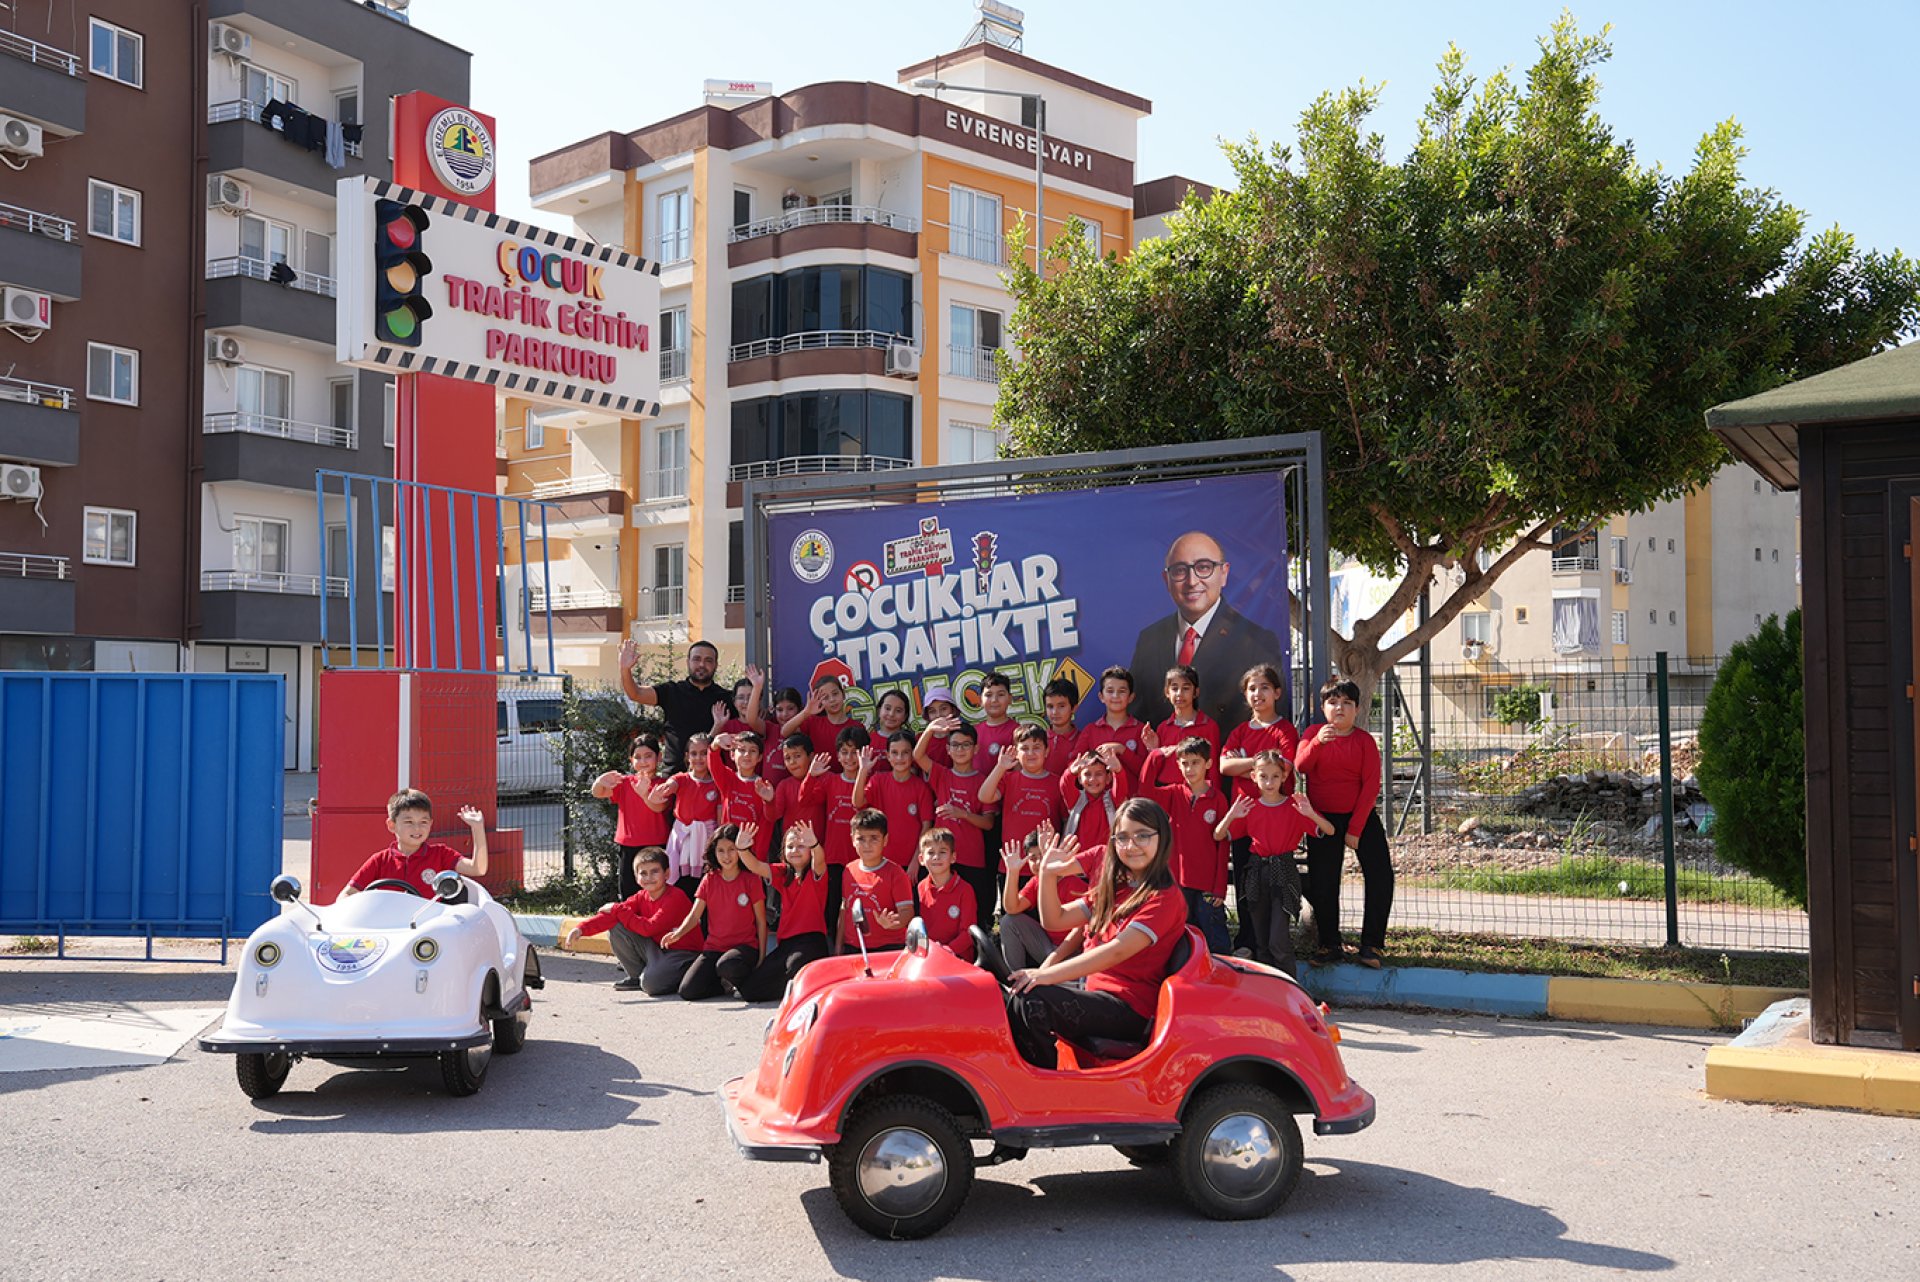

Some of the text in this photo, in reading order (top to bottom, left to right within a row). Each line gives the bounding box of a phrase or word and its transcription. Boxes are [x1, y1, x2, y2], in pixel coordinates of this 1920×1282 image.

[497, 240, 605, 300] ÇOCUK
[443, 273, 649, 352] TRAFİK EĞİTİM
[486, 329, 617, 384] PARKURU
[809, 553, 1060, 654] ÇOCUKLAR
[837, 598, 1080, 680] TRAFİKTE
